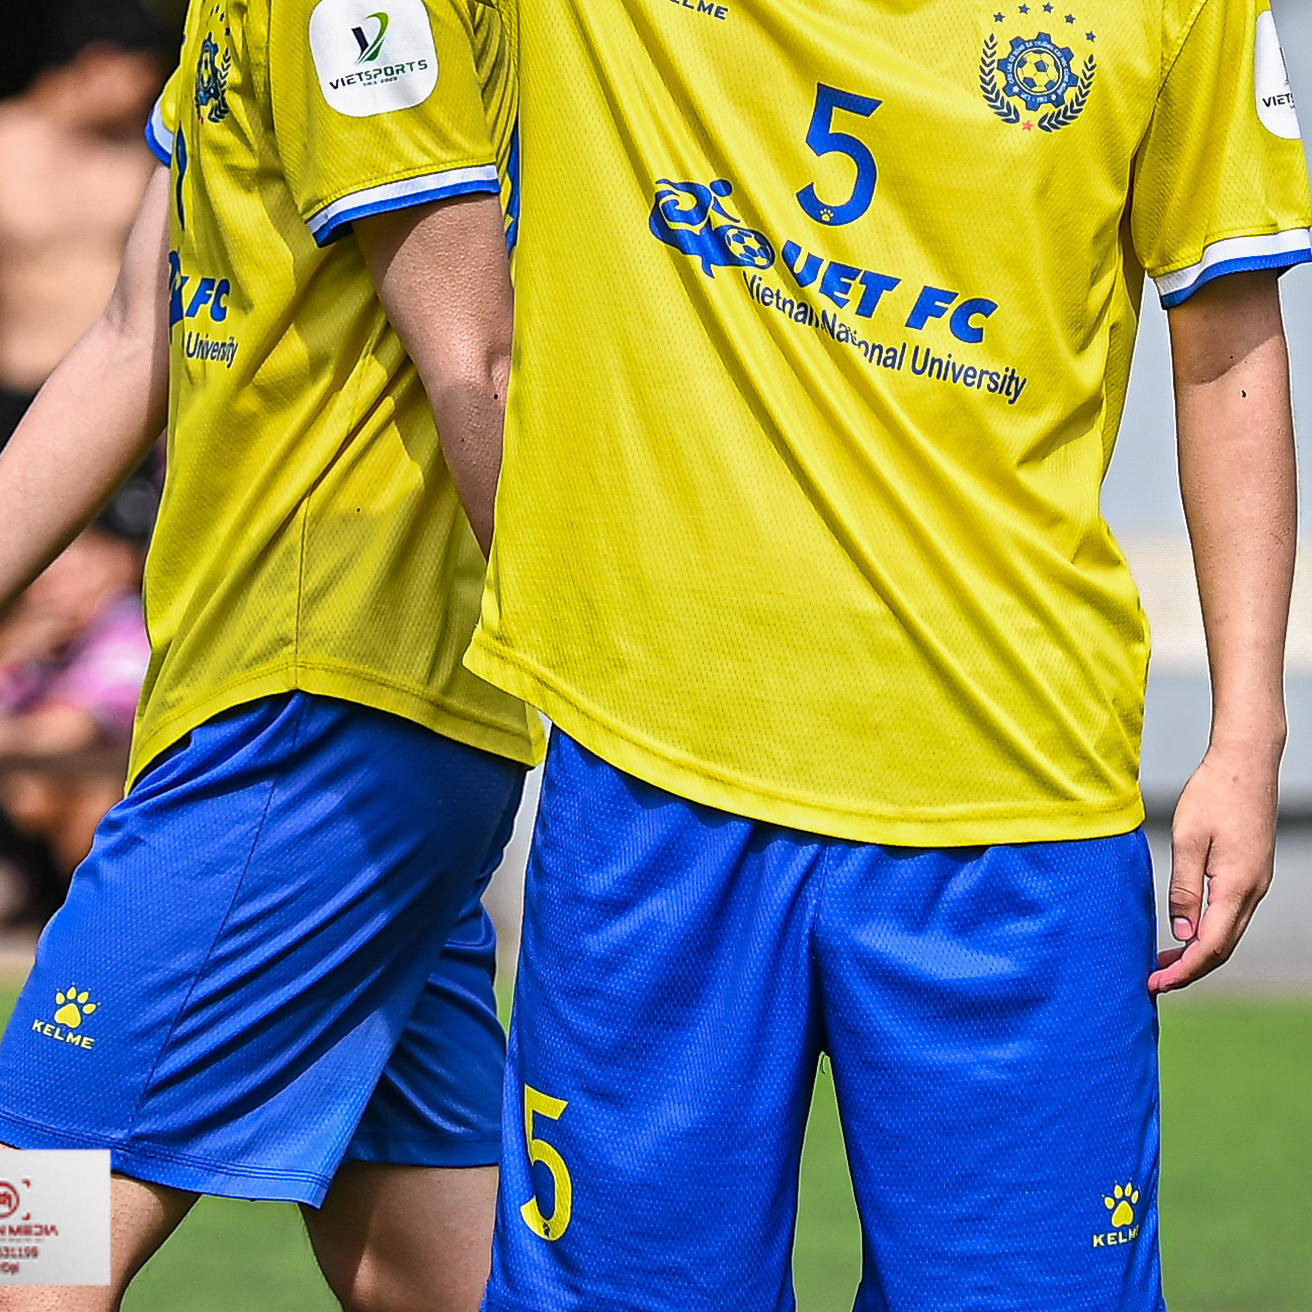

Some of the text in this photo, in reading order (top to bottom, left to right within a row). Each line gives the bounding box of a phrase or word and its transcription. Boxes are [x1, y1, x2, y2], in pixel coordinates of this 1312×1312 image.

[329, 59, 428, 90] VIETSPORTS
[795, 82, 883, 227] 5
[186, 277, 230, 322] FC
[782, 239, 999, 344] UET FC
[911, 345, 1027, 405] University
[32, 1019, 95, 1049] KELME
[520, 1083, 573, 1242] 5
[1093, 1225, 1140, 1248] KELM
